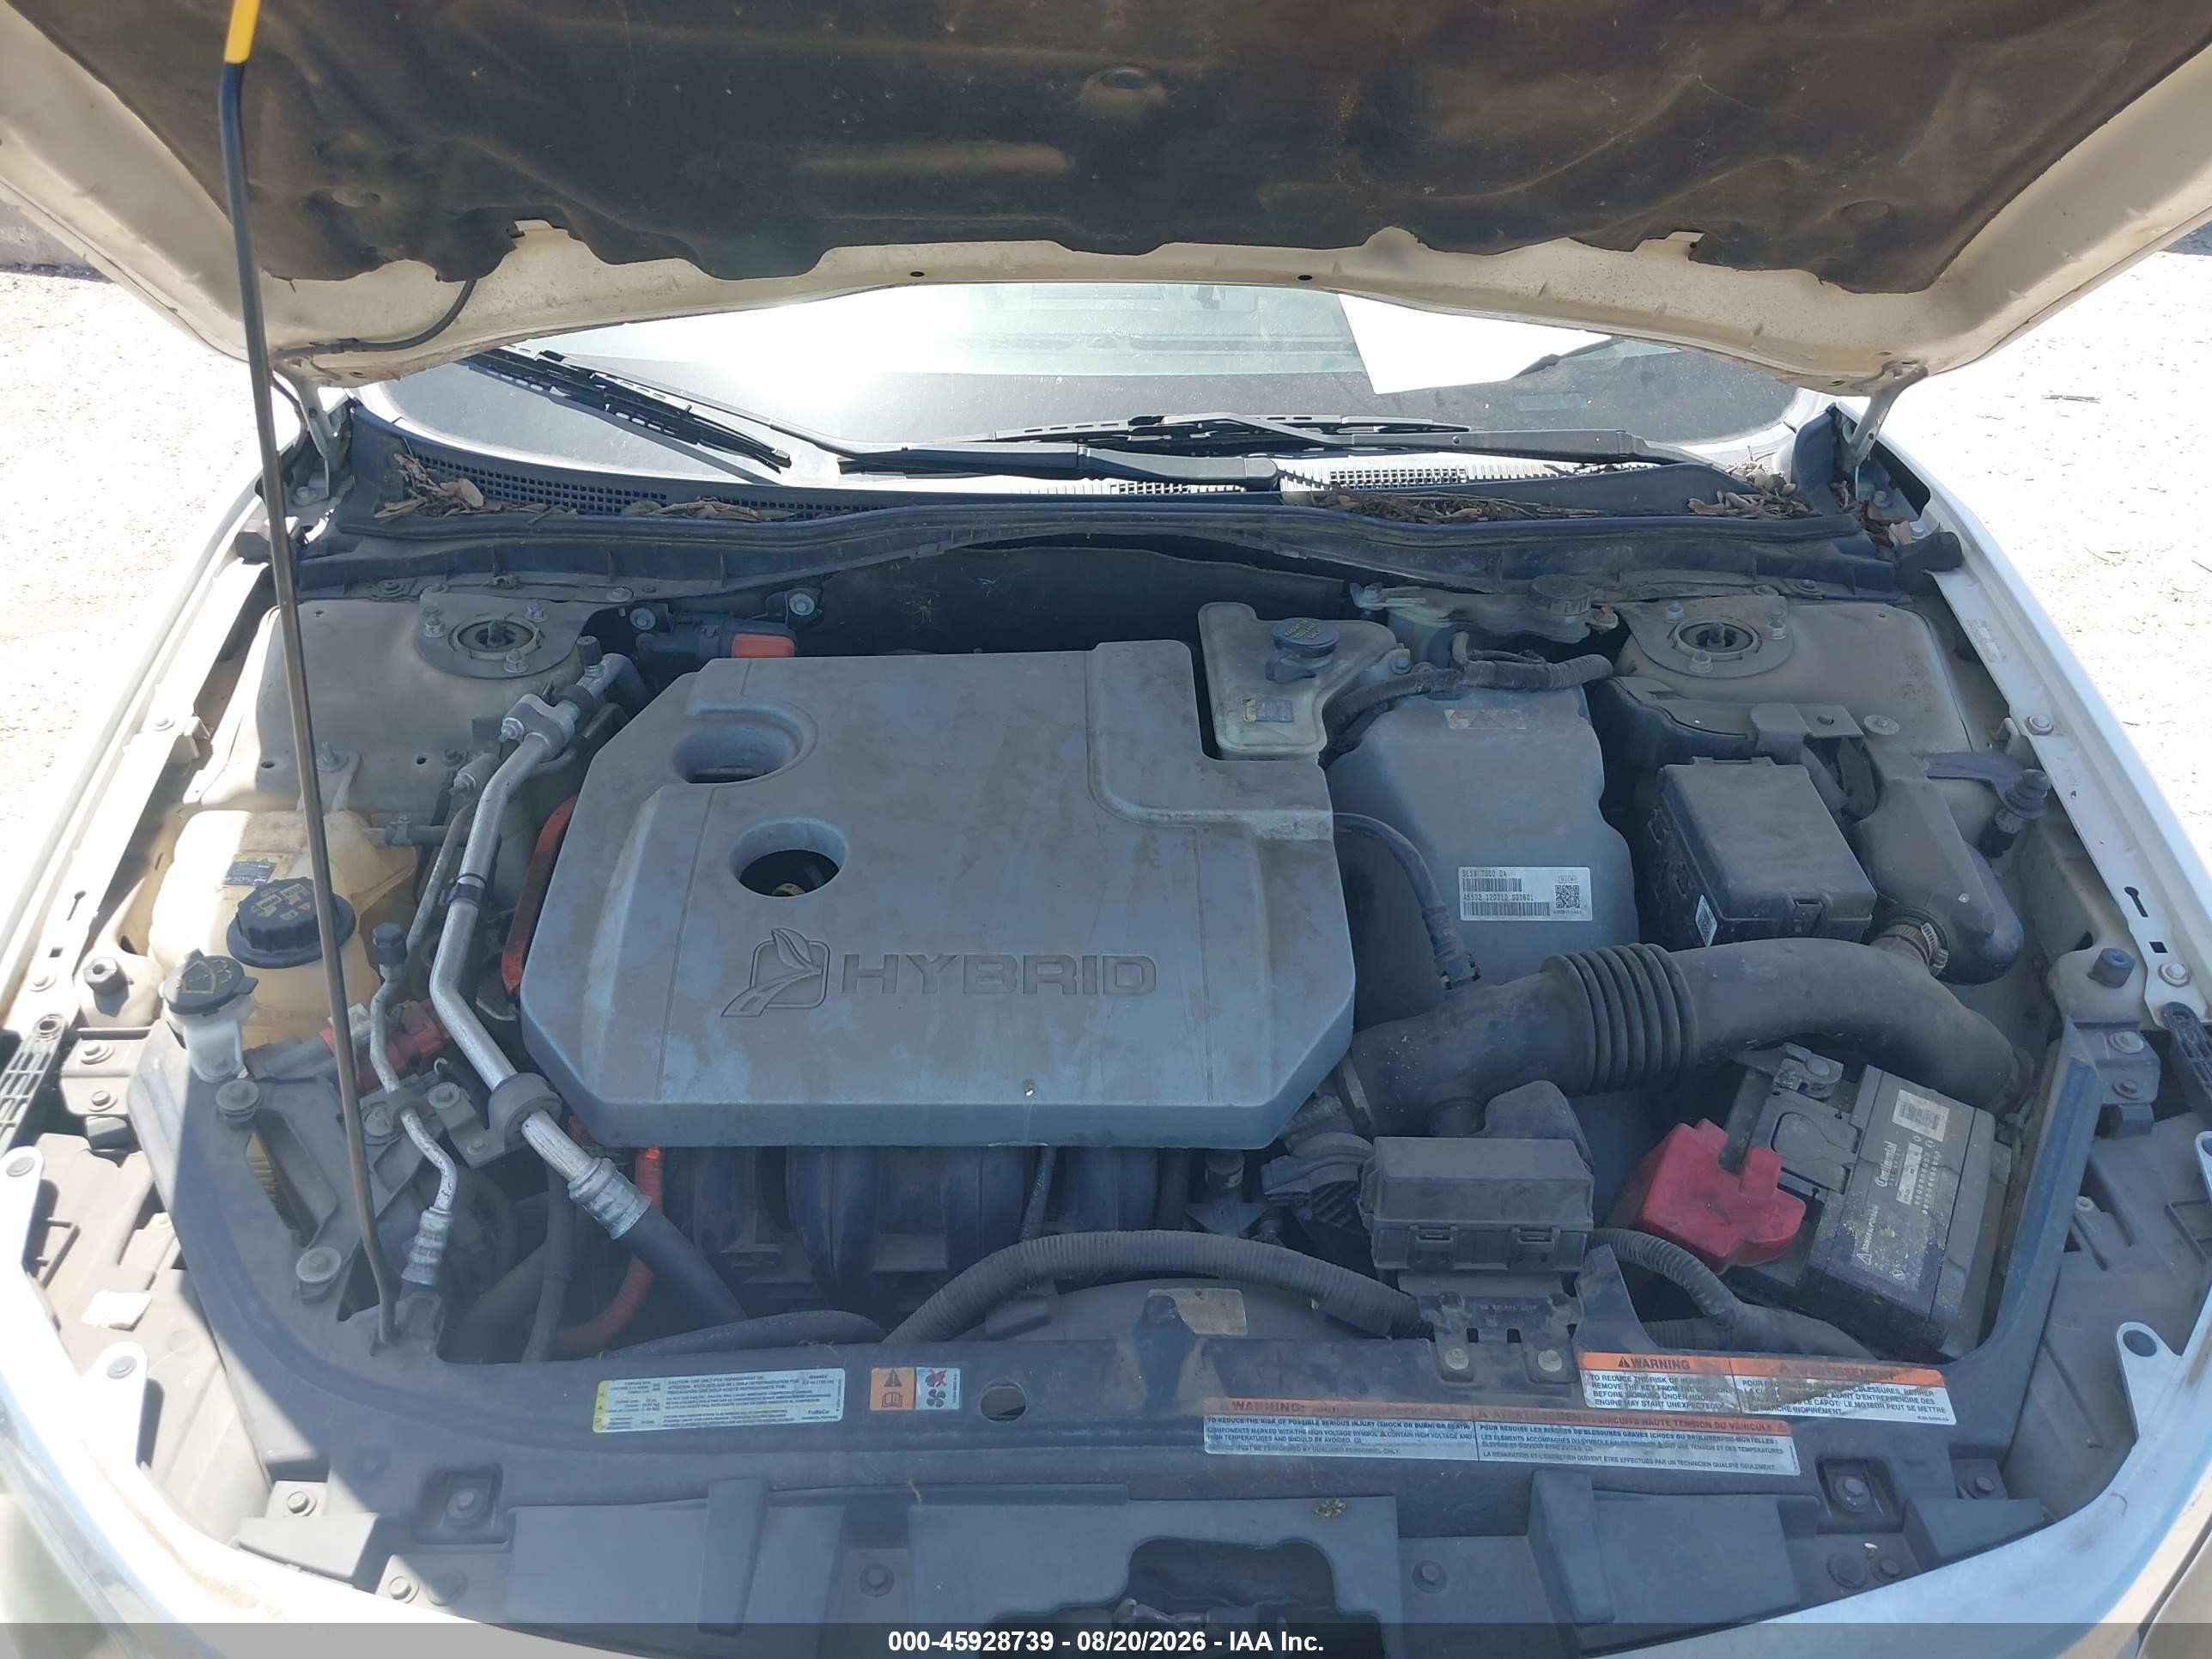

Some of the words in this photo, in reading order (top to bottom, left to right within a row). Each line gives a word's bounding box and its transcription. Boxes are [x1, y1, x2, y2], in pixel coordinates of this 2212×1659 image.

[842, 953, 1158, 995] HYBRID
[1631, 1358, 1691, 1370] WARNING
[1642, 1419, 1670, 1427] HAUTE
[1674, 1419, 1712, 1429] TENSION
